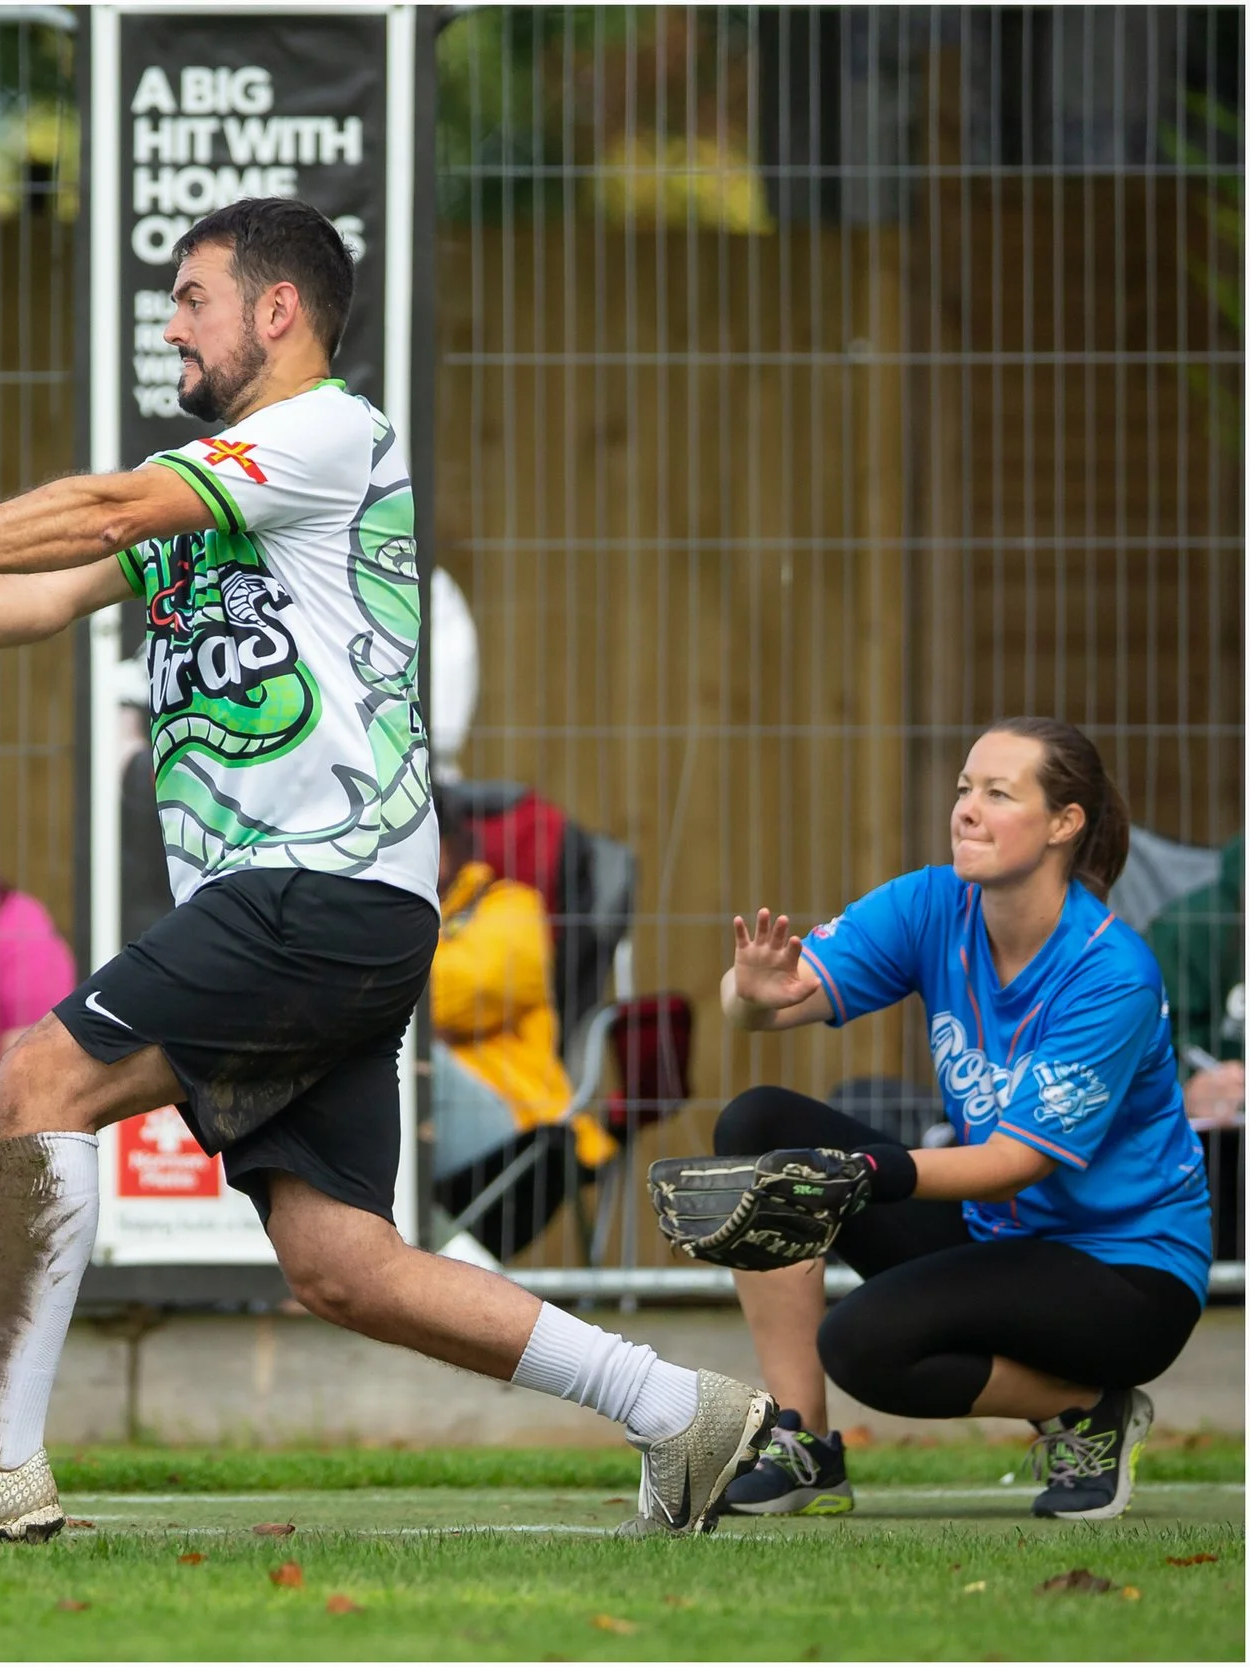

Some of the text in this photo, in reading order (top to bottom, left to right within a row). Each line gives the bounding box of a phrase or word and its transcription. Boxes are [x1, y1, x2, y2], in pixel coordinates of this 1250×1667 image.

[131, 65, 274, 115] A BIG
[133, 116, 363, 164] HIT WITH
[133, 167, 298, 214] HOME
